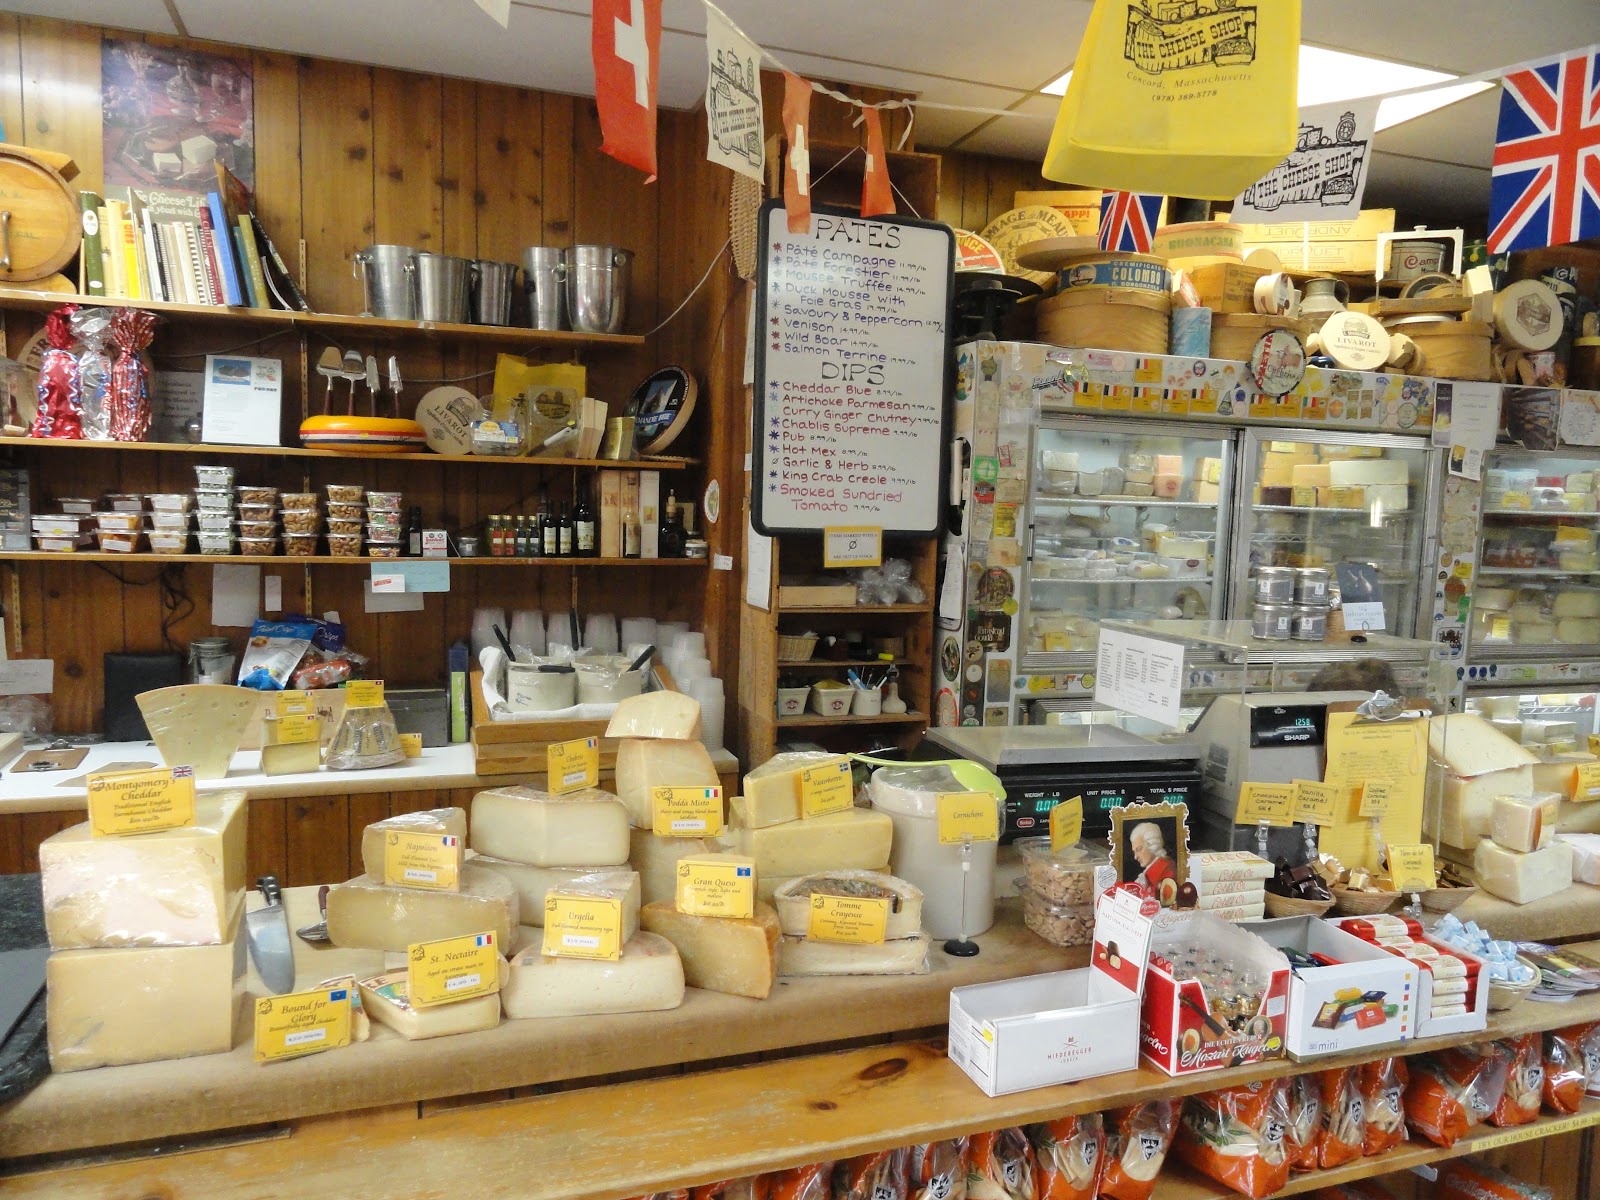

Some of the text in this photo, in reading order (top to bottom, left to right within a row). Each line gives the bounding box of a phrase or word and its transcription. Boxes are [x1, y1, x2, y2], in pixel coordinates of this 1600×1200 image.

[1137, 15, 1243, 59] THE CHEESE SHOP
[1126, 71, 1252, 89] Concord, Massachusetts
[1151, 93, 1174, 102] (978)
[1257, 151, 1352, 198] THE CHEESE SHOP
[786, 243, 818, 258] Pâté
[823, 248, 896, 268] Campagne
[824, 262, 891, 279] Forestier
[1112, 267, 1161, 285] COLOMBO
[785, 269, 834, 283] Mousse
[841, 276, 892, 291] Truffée
[785, 282, 906, 307] Duck Mousse with
[800, 296, 824, 306] Foie
[829, 298, 862, 310] Gras
[785, 305, 839, 322] Savoury
[842, 311, 850, 321] &
[854, 312, 923, 328] Peppercorn
[784, 318, 834, 333] Venison
[785, 332, 809, 343] Wild
[815, 333, 849, 345] Boar
[1337, 337, 1377, 348] LIVAROT
[784, 343, 830, 356] Salmon
[836, 348, 887, 363] Terrine
[821, 361, 885, 386] DIPS
[782, 381, 840, 394] Cheddar
[846, 384, 872, 396] Blue
[782, 394, 843, 407] Artichoke
[847, 397, 911, 411] Parmesan
[434, 405, 467, 438] LIVAROT
[783, 406, 820, 420] Curry
[824, 410, 863, 423] Ginger
[867, 413, 917, 427] Chutney
[782, 419, 830, 432] Chablis
[834, 422, 890, 436] Supreme
[782, 432, 805, 441] Pub
[782, 444, 807, 455] Hot
[811, 446, 837, 456] Mex
[782, 456, 820, 469] Garlic
[825, 459, 833, 469] &
[838, 460, 869, 471] Herb
[782, 470, 808, 483] King
[811, 471, 844, 483] Crab
[848, 474, 887, 485] Creole
[780, 484, 903, 503] Smoked Sundried
[791, 498, 849, 512] Tomato
[104, 776, 176, 792] Montgomery's
[121, 790, 162, 801] Cheddar
[1252, 792, 1288, 800] Chocolate
[1298, 794, 1328, 804] Caramel
[1301, 789, 1325, 797] Vanilla
[690, 799, 710, 807] Misto
[1255, 798, 1285, 806] Caramel
[953, 811, 984, 820] Cornichons
[693, 878, 736, 890] Gran Queso
[836, 901, 862, 910] Tomme
[568, 912, 595, 923] Urgelia
[830, 909, 862, 919] Crayeuse
[430, 949, 479, 964] St. Nectaire
[282, 1000, 328, 1014] Bound for
[291, 1013, 317, 1024] Glory
[1204, 1040, 1215, 1048] DIE
[1318, 1040, 1338, 1051] mini
[1181, 1048, 1231, 1068] Mozart
[1510, 1131, 1533, 1142] HOUSE
